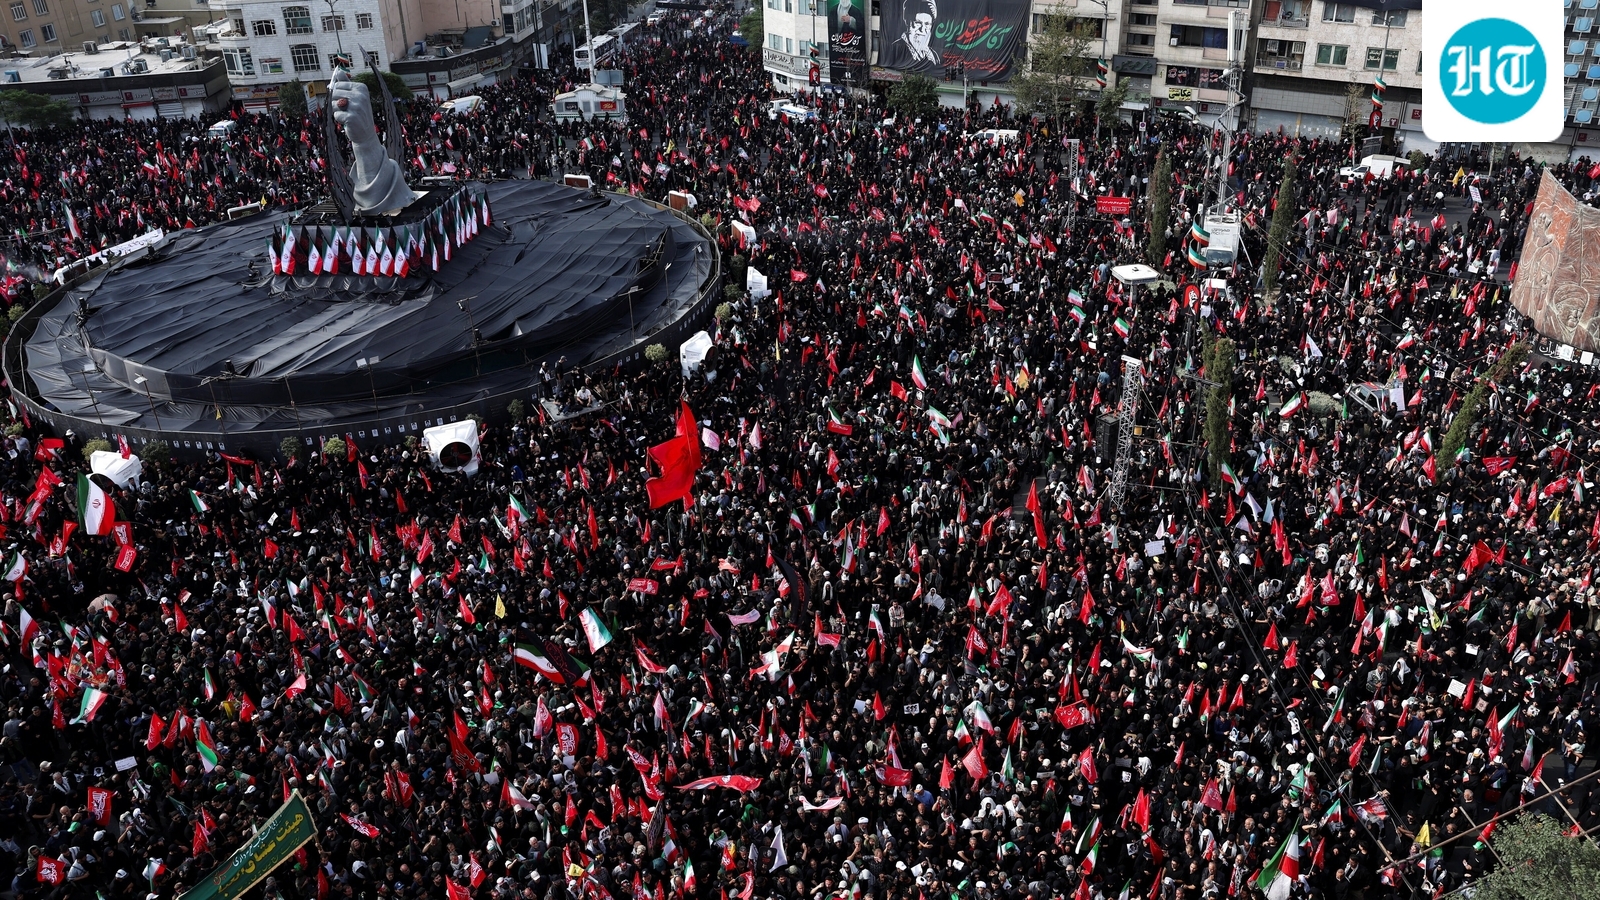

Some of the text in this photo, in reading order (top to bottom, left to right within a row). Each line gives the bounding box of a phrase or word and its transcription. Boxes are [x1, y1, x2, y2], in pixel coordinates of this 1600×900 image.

[935, 16, 1013, 50] آقای شهید ایران
[1169, 89, 1191, 99] عکاسی
[276, 813, 304, 843] هیئت
